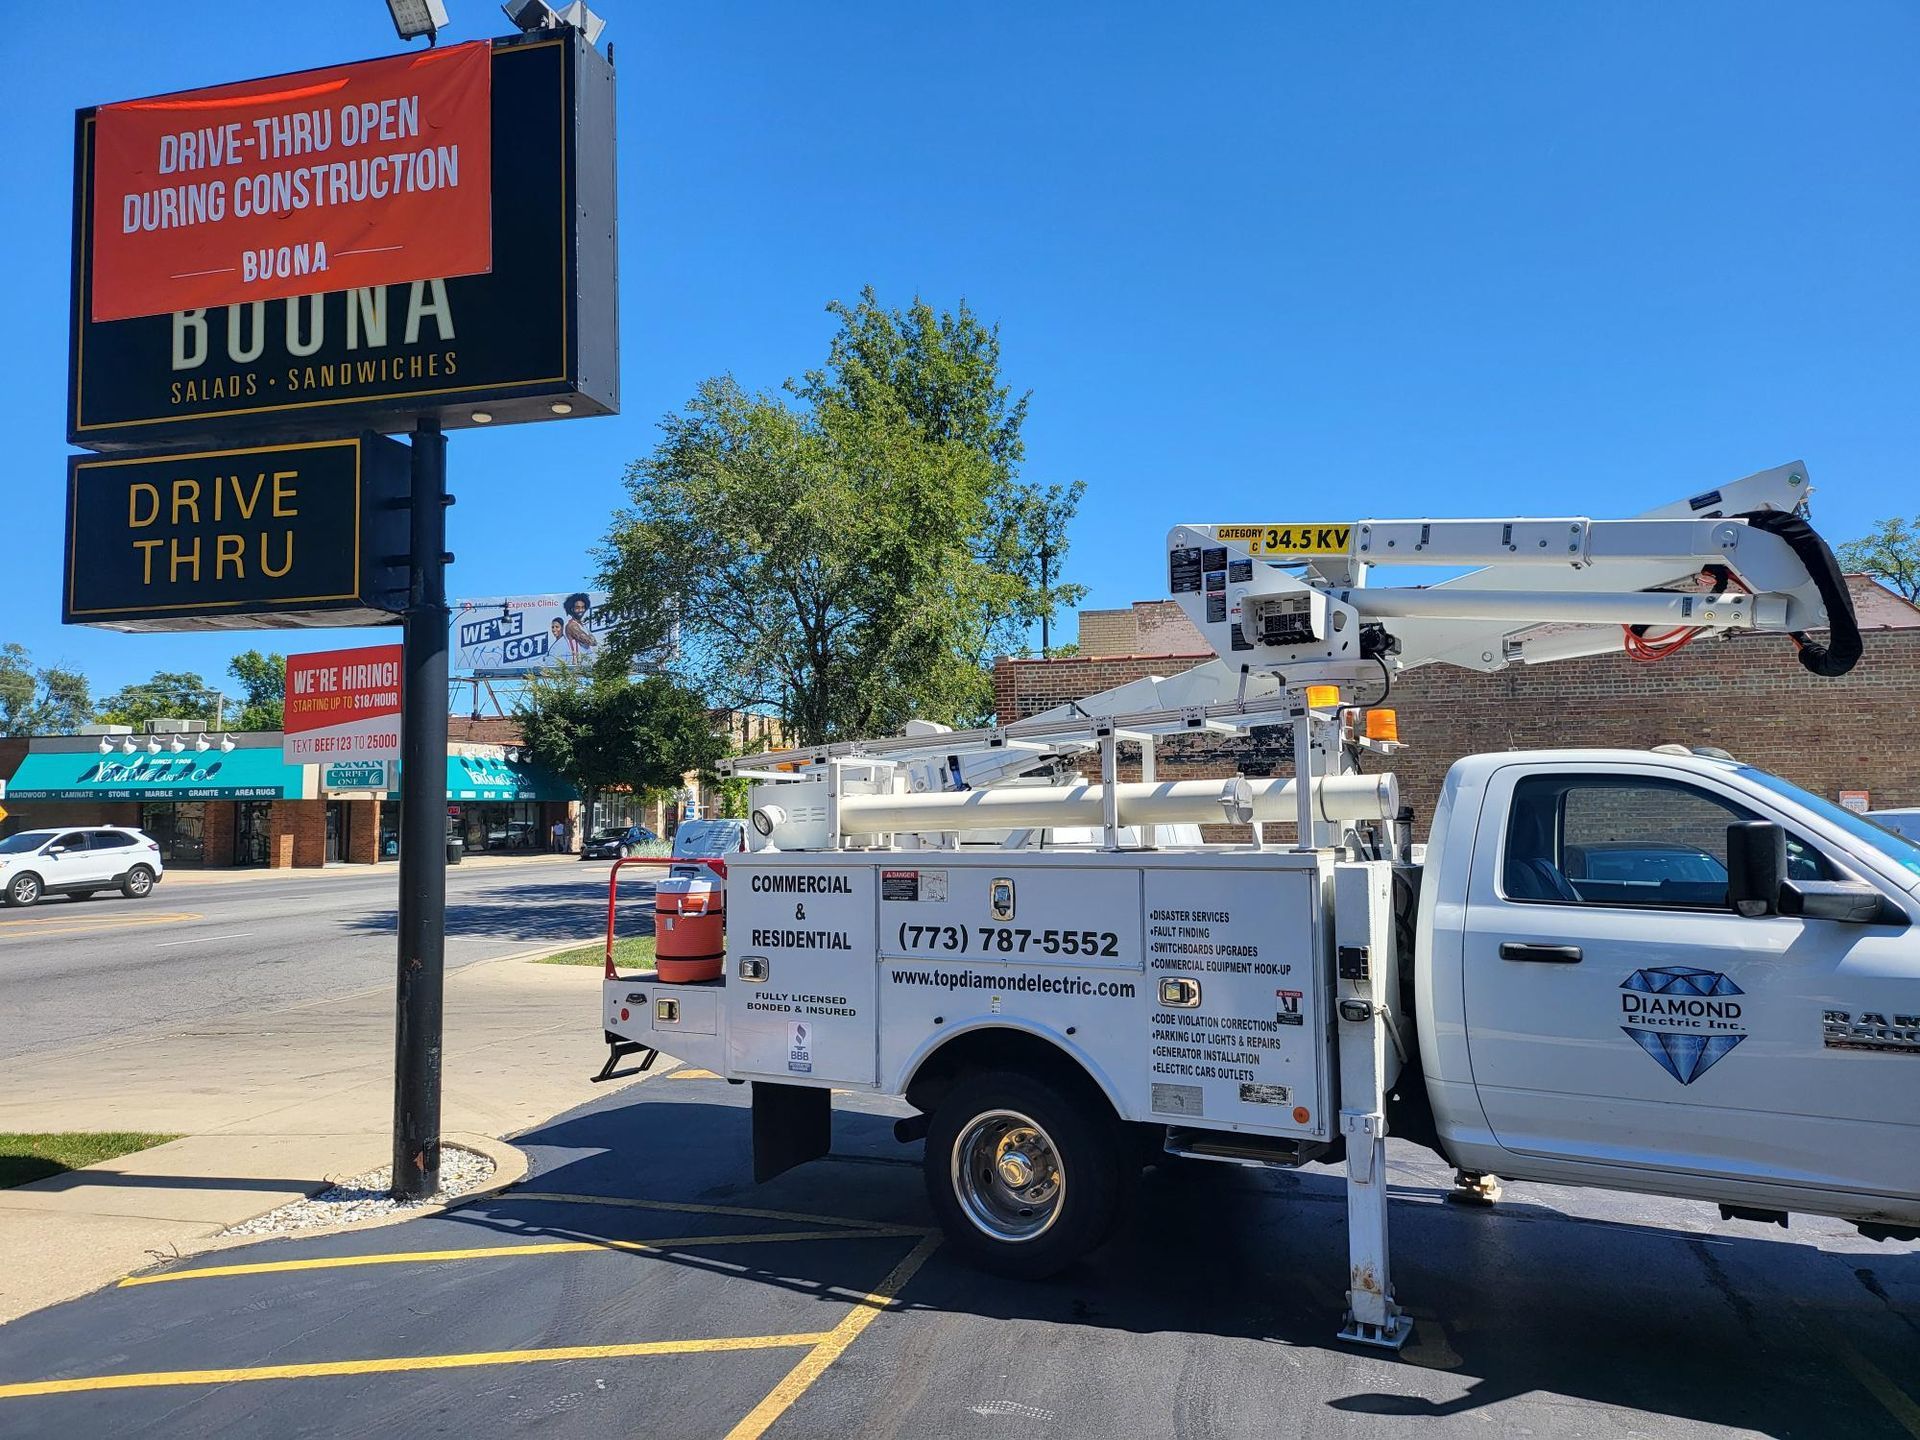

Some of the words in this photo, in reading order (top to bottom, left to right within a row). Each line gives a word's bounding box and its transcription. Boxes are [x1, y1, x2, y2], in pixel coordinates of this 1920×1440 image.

[159, 105, 333, 175] DRIVE-THRU
[341, 96, 419, 144] OPEN
[123, 180, 226, 234] DURING
[233, 145, 458, 218] CONSTRUCTION
[243, 241, 327, 283] BUONA
[171, 374, 257, 404] SALADS
[288, 352, 457, 391] SANDWICHES
[129, 470, 299, 529] DRIVE
[1219, 528, 1263, 539] CATEGORY
[1266, 529, 1312, 550] 34.5
[1316, 529, 1350, 549] KV
[1252, 542, 1259, 552] C
[133, 530, 294, 585] THRU
[507, 601, 536, 609] Express
[537, 600, 559, 608] Clinic
[463, 615, 520, 644] WE'VE
[505, 634, 547, 660] GOT
[294, 667, 338, 694] WE'RE
[342, 662, 398, 690] HIRING!
[293, 697, 329, 713] STARTING
[330, 696, 341, 710] UP
[343, 695, 352, 709] TO
[354, 692, 397, 709] $18/HOUR
[292, 739, 312, 753] TEXT
[354, 735, 364, 749] TO
[367, 733, 397, 748] 25000
[9, 791, 47, 799] HARDWOOD
[108, 790, 130, 798] STONE
[145, 790, 173, 798] MARBLE
[188, 789, 219, 797] GRANITE
[255, 788, 276, 796] RUGS
[751, 875, 852, 894] COMMERCIAL
[795, 903, 806, 921] &
[1154, 910, 1190, 922] DISASTER
[1192, 911, 1230, 923] SERVICES
[751, 929, 852, 950] RESIDENTIAL
[898, 922, 969, 953] (773)
[978, 928, 1119, 957] 787-5552
[1154, 926, 1176, 938] FAULT
[1178, 927, 1210, 938] FINDING
[1154, 942, 1214, 955] SWITCHBOARDS
[1216, 945, 1258, 957] UPGRADES
[1154, 958, 1204, 971] COMMERCIAL
[1206, 961, 1252, 974] EQUIPMENT
[1254, 963, 1291, 976] HOOK-UP
[891, 969, 1136, 998] www.topdiamondelectric.com
[755, 991, 789, 1003] FULLY
[792, 993, 847, 1005] LICENSED
[1622, 993, 1742, 1019] DIAMOND
[747, 1002, 791, 1013] BONDED
[794, 1004, 802, 1014] &
[806, 1004, 857, 1017] INSURED
[1155, 1014, 1176, 1026] CODE
[1177, 1015, 1219, 1028] VIOLATION
[1221, 1018, 1278, 1032] CORRECTIONS
[1628, 1015, 1701, 1028] Electric
[1708, 1020, 1747, 1030] Inc.
[1155, 1030, 1189, 1042] PARKING
[1191, 1032, 1207, 1044] LOT
[1208, 1034, 1236, 1046] LIGHTS
[1239, 1036, 1245, 1046] &
[1247, 1037, 1281, 1049] REPAIRS
[791, 1051, 809, 1061] BBB
[1156, 1047, 1202, 1060] GENERATOR
[1203, 1050, 1260, 1065] INSTALLATION
[1156, 1063, 1193, 1076] ELECTRIC
[1195, 1066, 1216, 1078] CARS
[1218, 1068, 1254, 1081] OUTLETS
